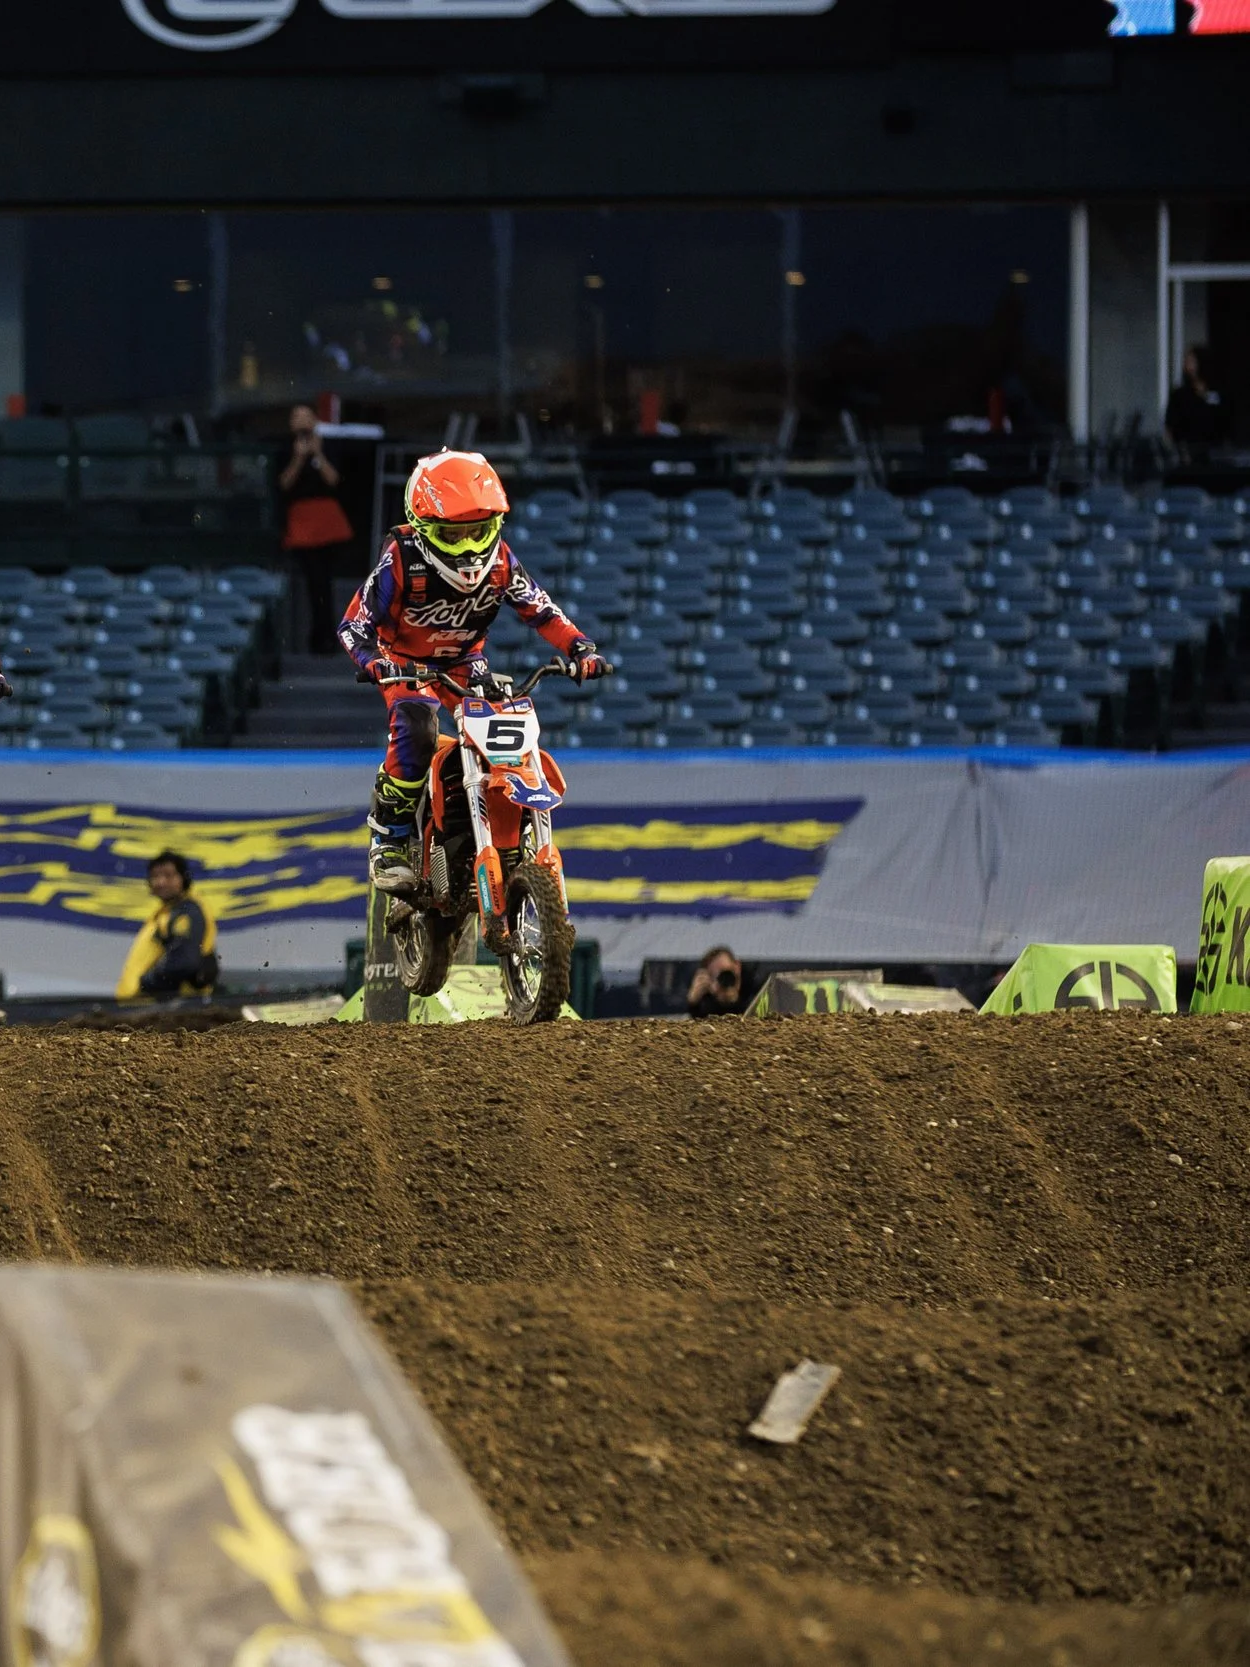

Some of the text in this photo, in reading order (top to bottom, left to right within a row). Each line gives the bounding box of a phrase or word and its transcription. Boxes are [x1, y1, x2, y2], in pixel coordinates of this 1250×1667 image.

[409, 562, 427, 571] KTM
[426, 629, 478, 643] KTM
[485, 719, 526, 751] 5
